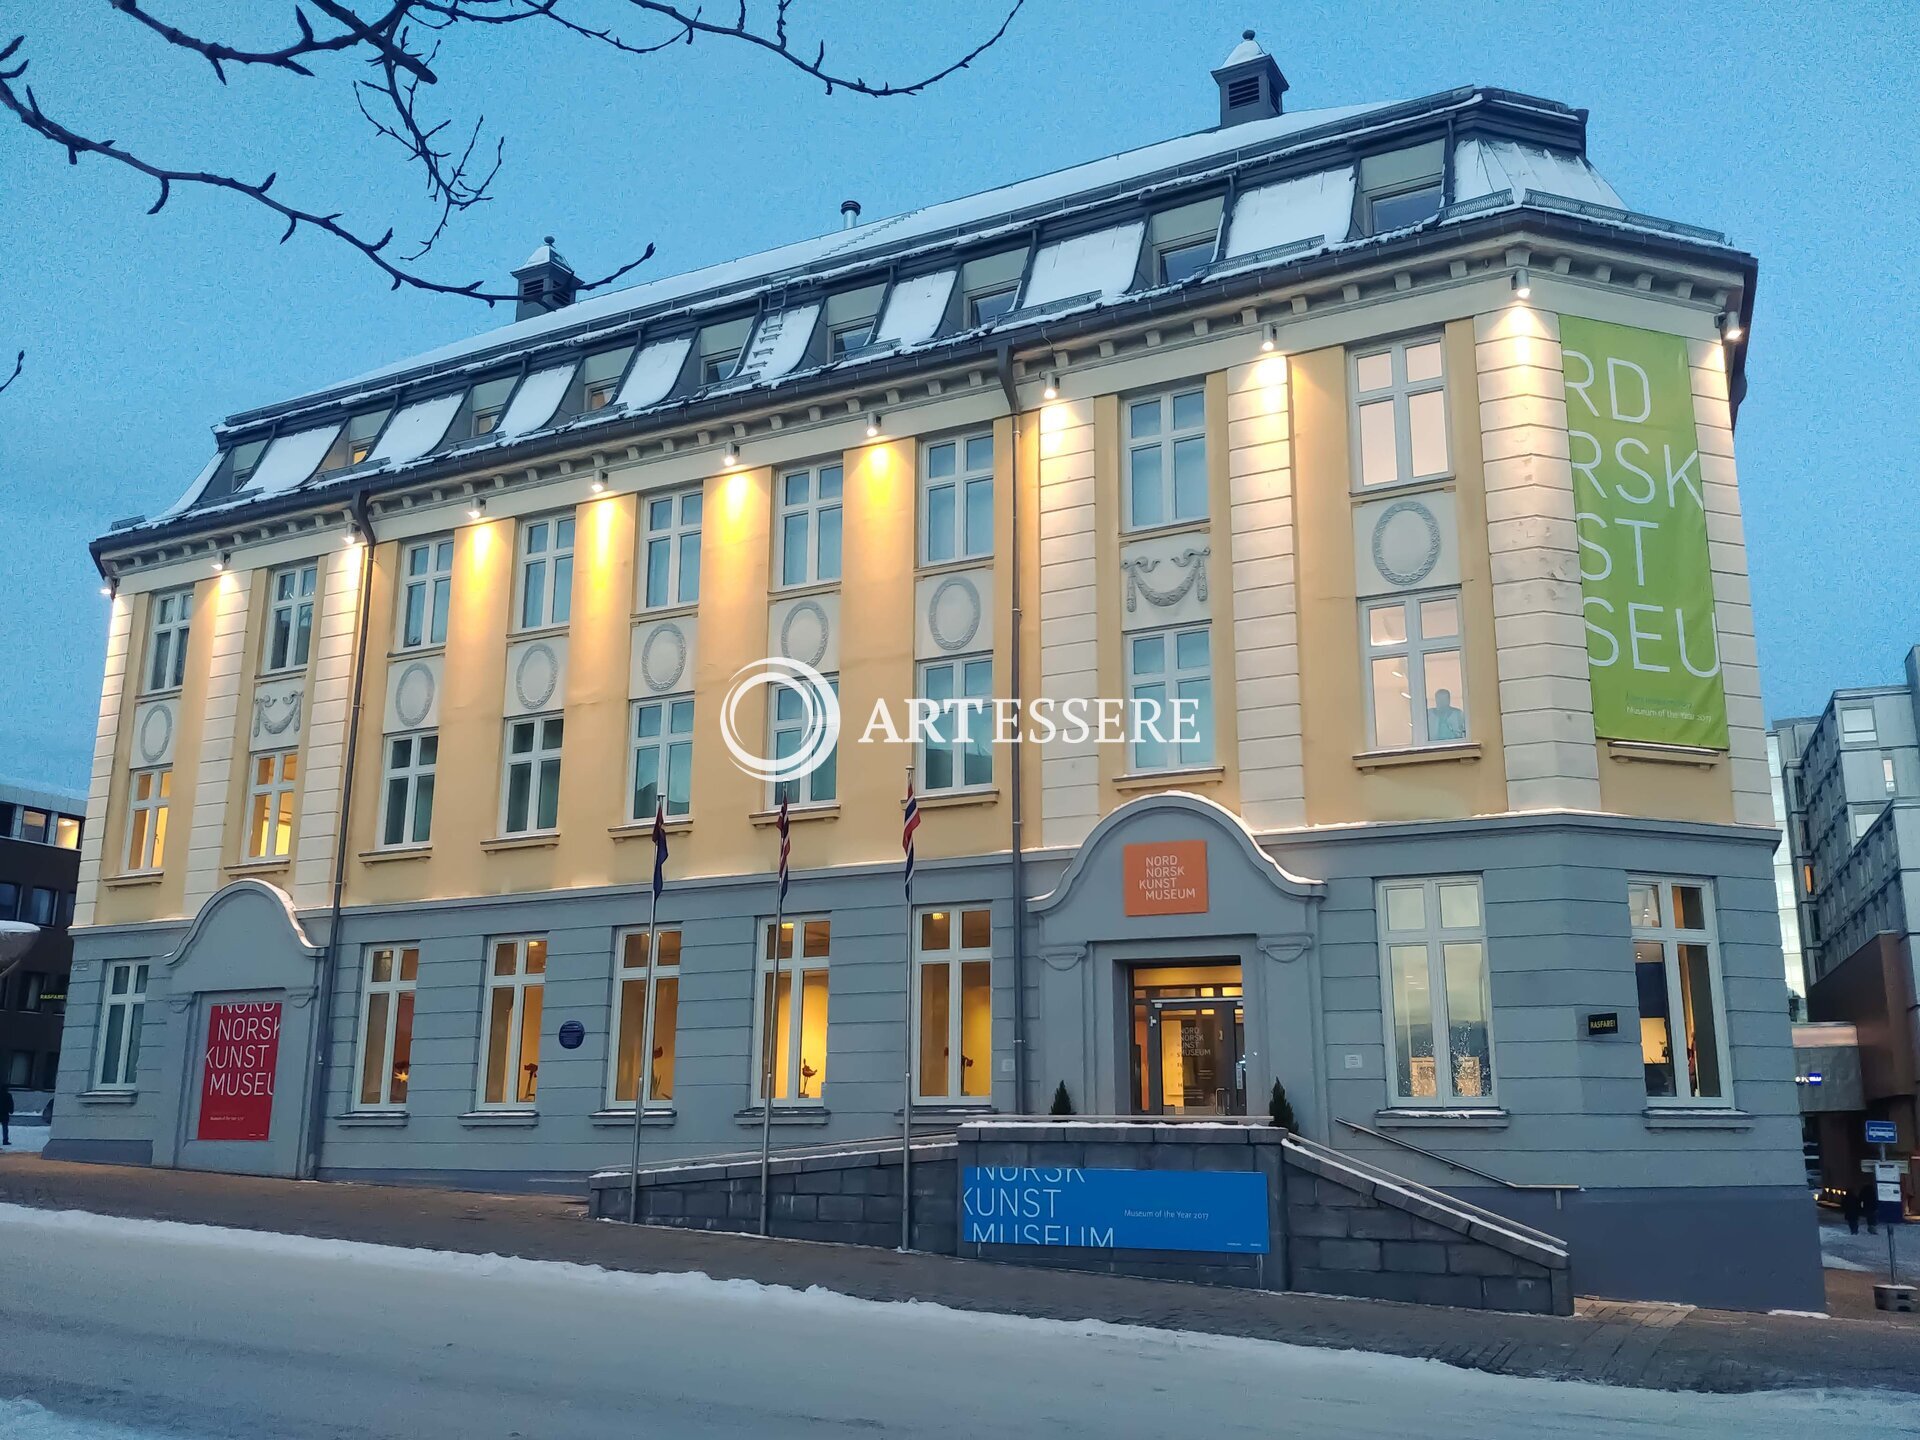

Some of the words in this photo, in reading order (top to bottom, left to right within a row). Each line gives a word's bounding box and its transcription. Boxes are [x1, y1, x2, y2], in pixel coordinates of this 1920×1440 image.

[1145, 855, 1178, 867] NORD
[1145, 866, 1185, 878] NORSK
[1138, 877, 1177, 890] KUNST
[1145, 888, 1196, 901] MUSEUM
[1124, 1209, 1153, 1218] Museum
[1154, 1209, 1162, 1218] of
[1163, 1210, 1175, 1218] the
[1176, 1210, 1191, 1219] Year
[1193, 1212, 1209, 1220] 2017
